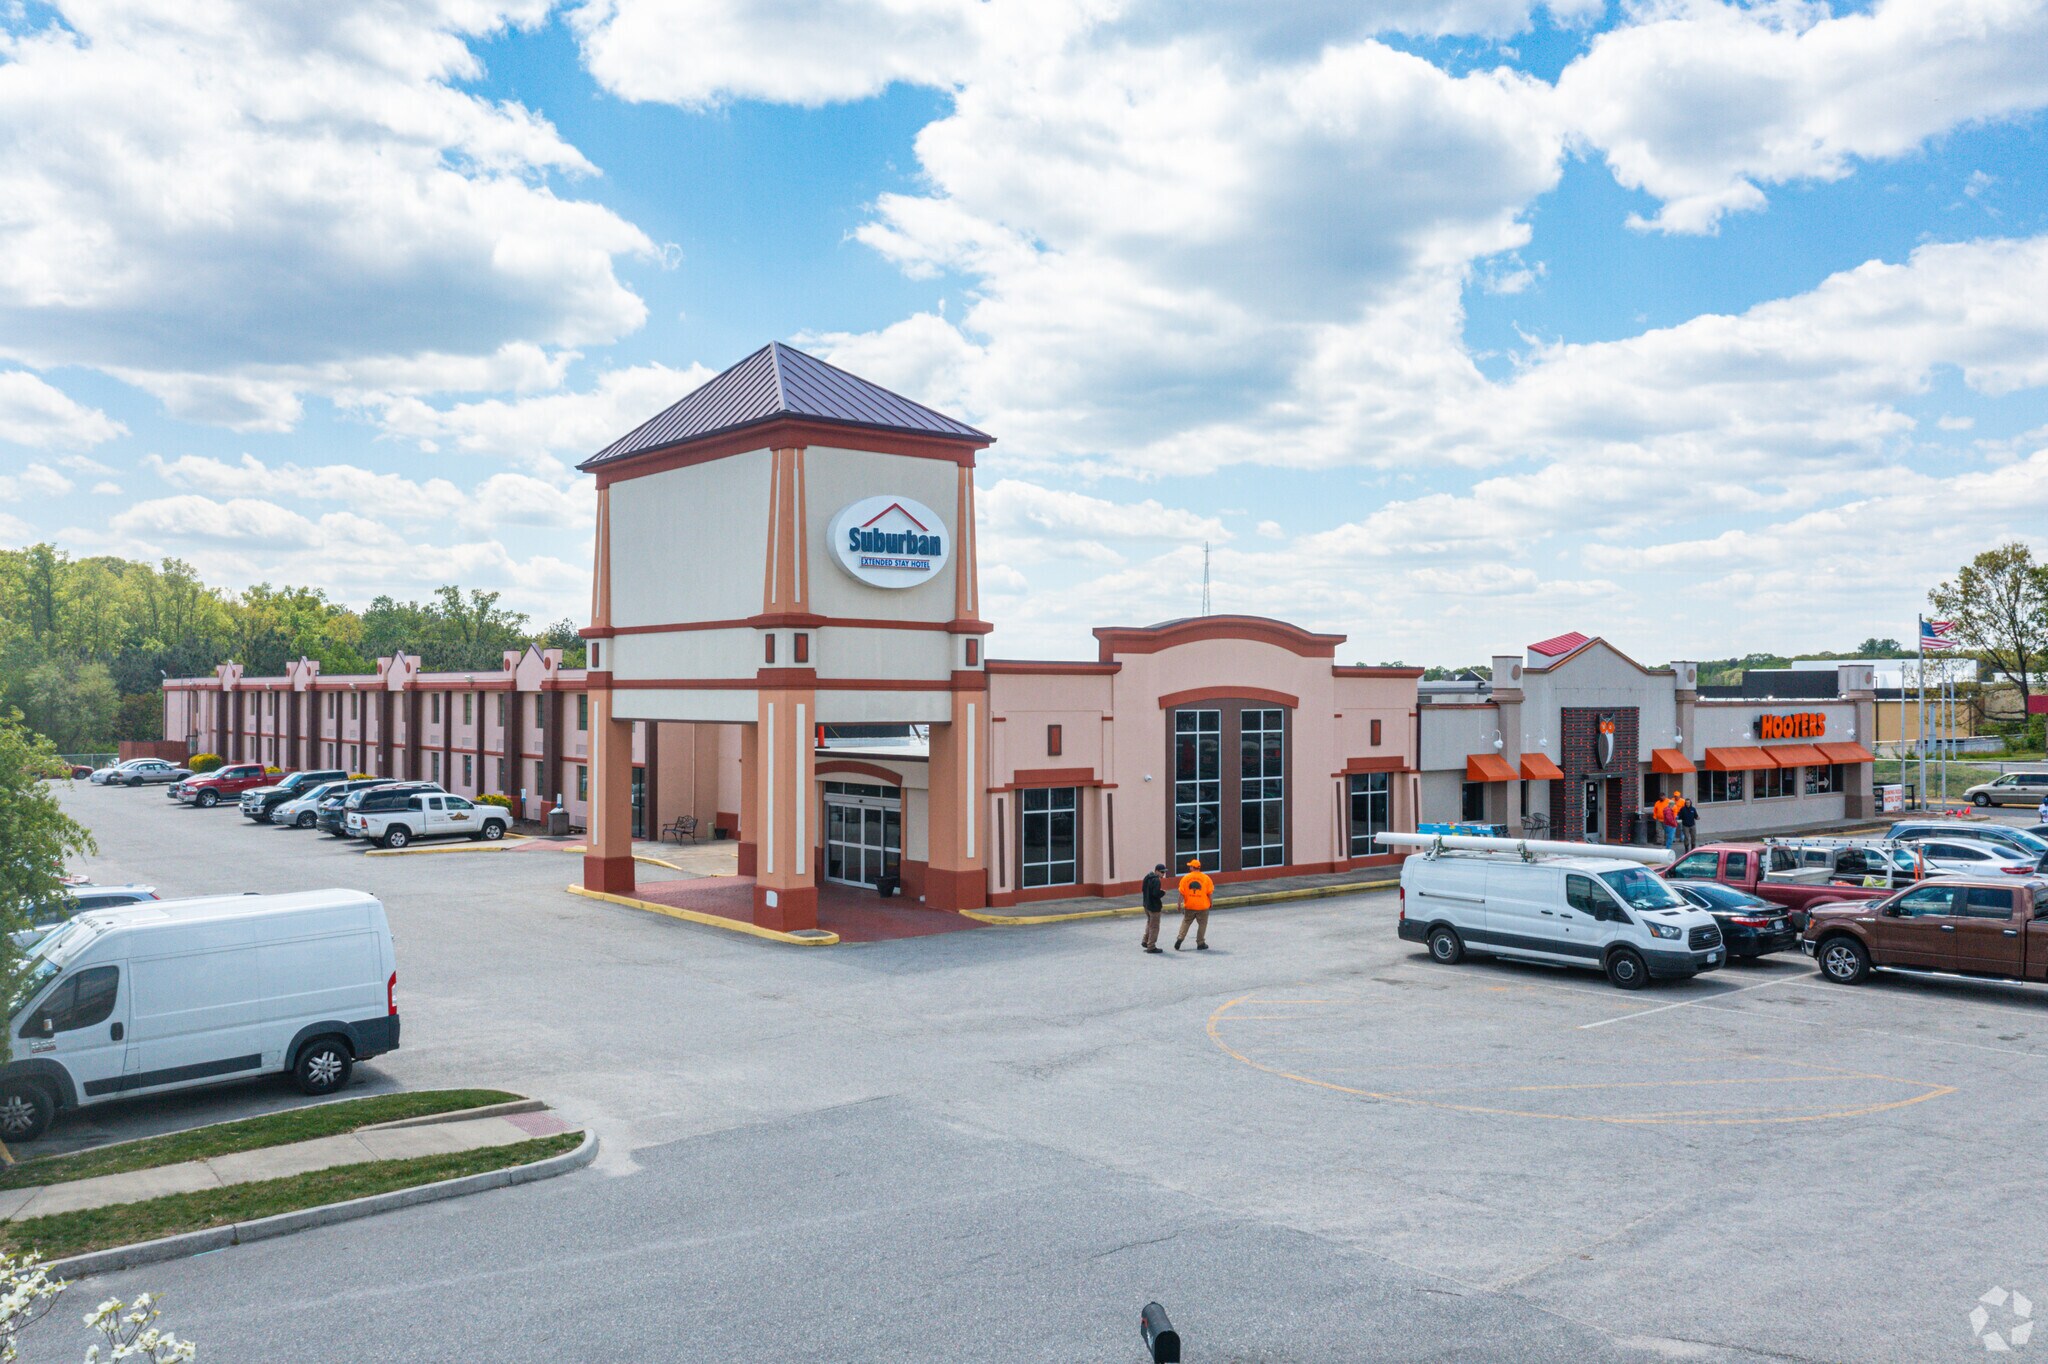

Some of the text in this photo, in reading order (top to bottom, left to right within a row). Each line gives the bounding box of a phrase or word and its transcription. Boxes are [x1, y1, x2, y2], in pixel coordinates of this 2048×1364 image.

[849, 527, 941, 556] Suburban
[861, 558, 930, 568] EXTENDED STAY HOTEL
[1761, 712, 1826, 740] HOOTERS
